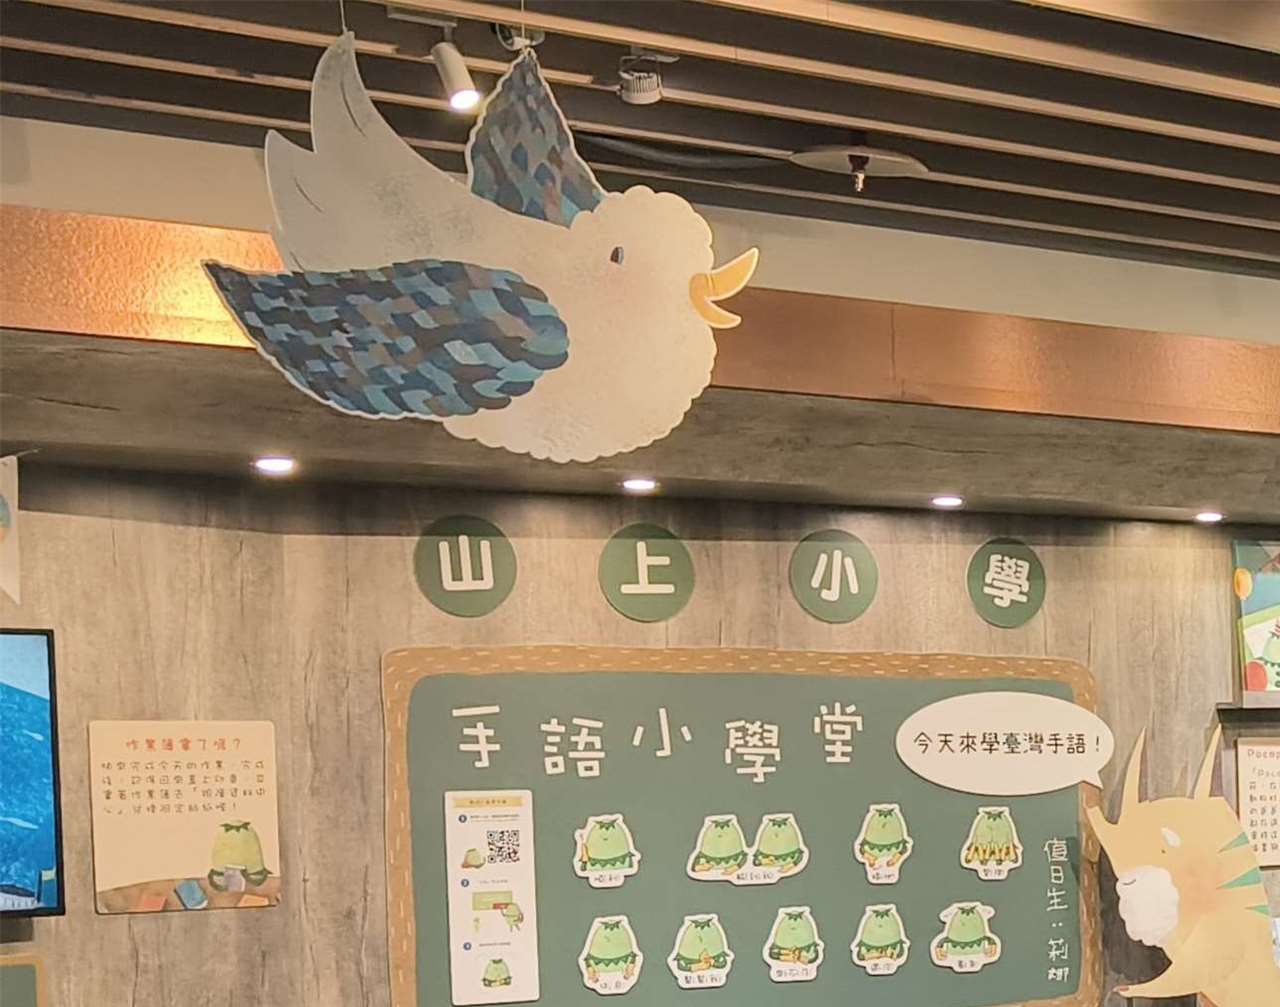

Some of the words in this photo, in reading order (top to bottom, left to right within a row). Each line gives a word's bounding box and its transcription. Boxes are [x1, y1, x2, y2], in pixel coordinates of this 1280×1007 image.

[452, 702, 863, 783] 手語小學堂
[913, 731, 1100, 755] 今天來學臺灣手語！
